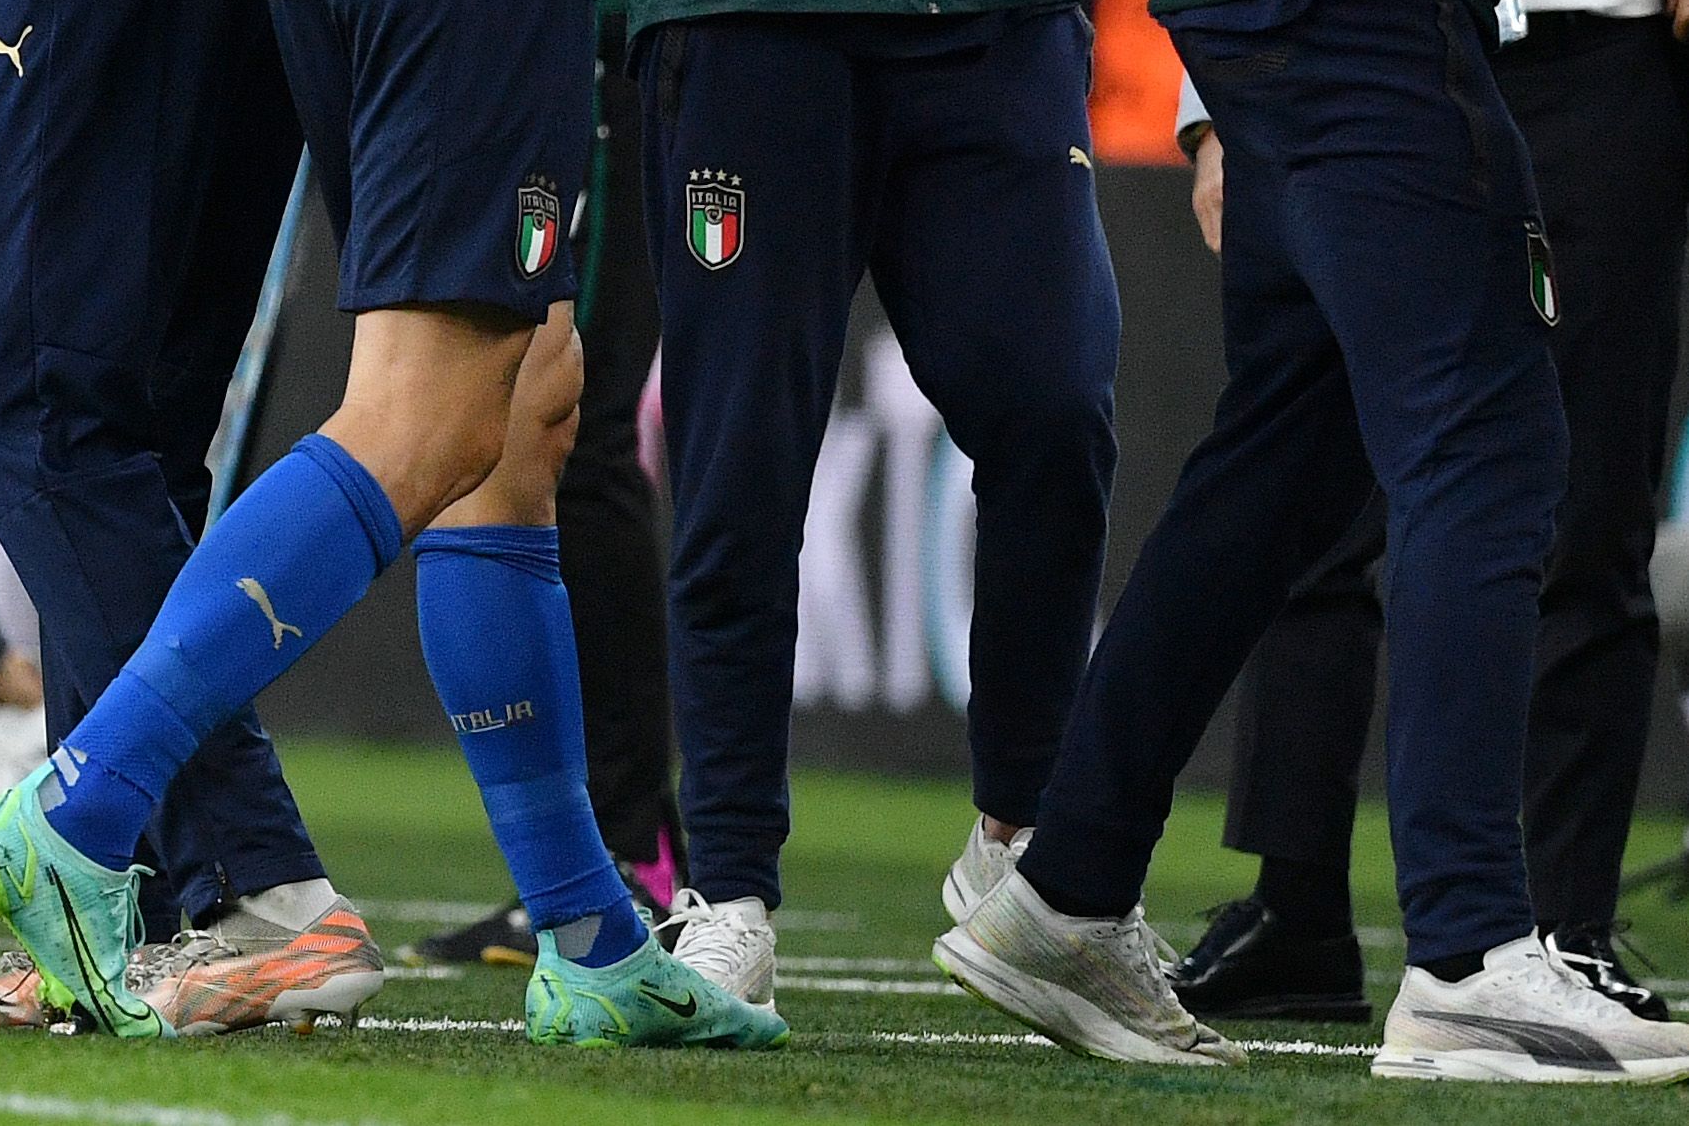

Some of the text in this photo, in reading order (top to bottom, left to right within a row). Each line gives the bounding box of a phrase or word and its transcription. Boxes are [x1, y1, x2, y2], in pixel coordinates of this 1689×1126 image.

[523, 195, 555, 214] ITALIA
[692, 191, 737, 208] ITALIA
[450, 700, 533, 732] ITALIA
